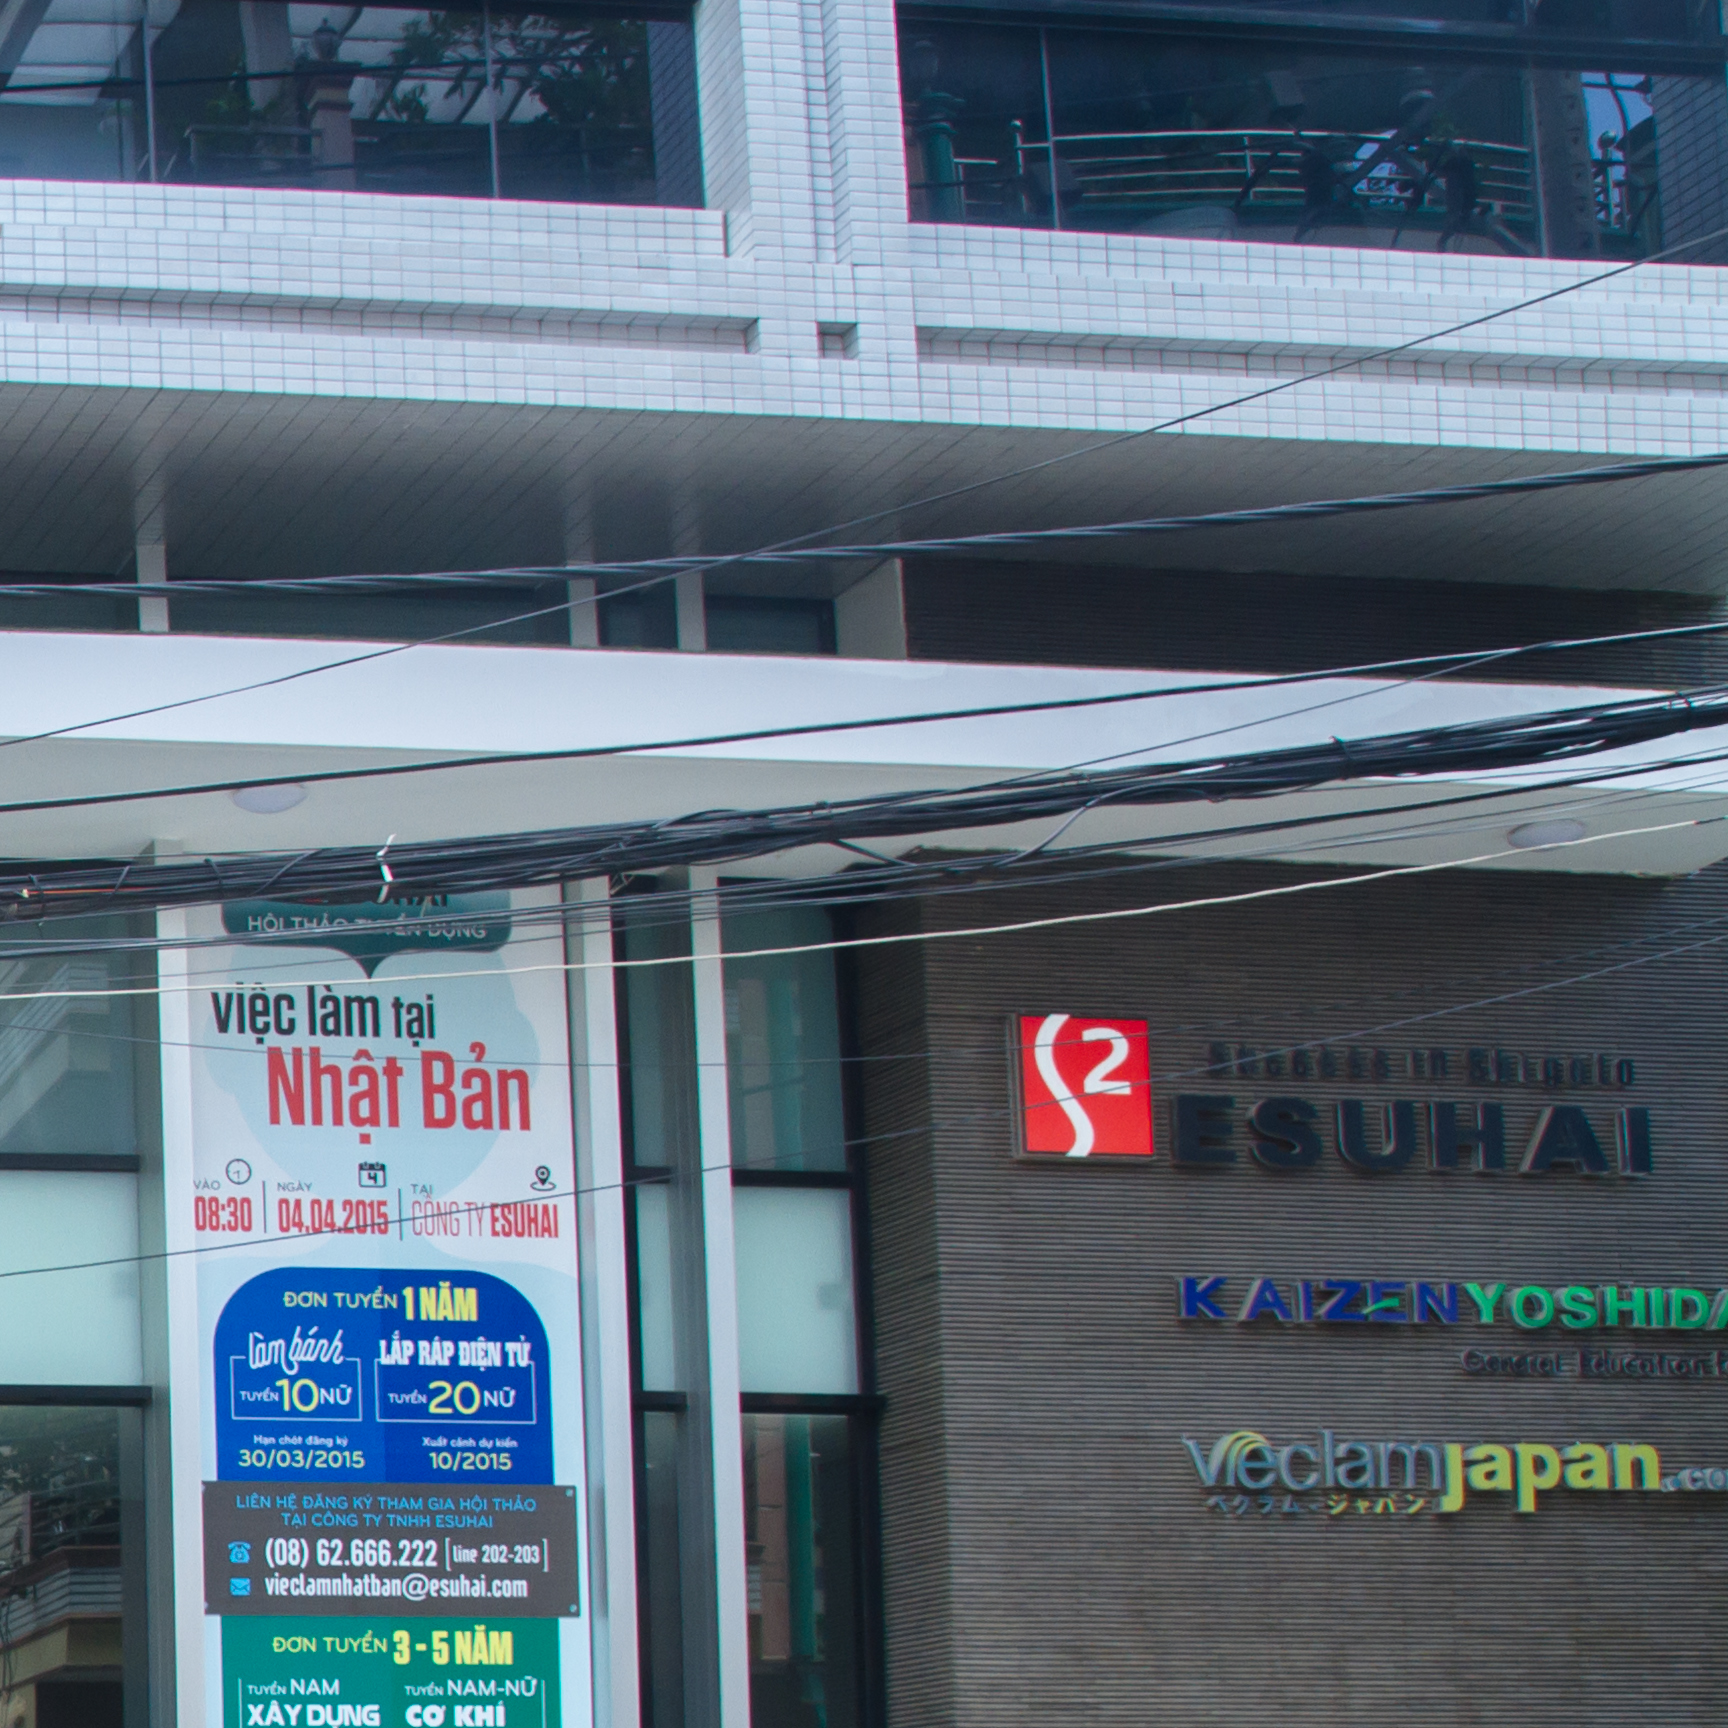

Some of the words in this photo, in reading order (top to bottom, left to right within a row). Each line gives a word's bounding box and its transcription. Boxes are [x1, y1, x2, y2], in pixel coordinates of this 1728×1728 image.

[210, 982, 294, 1044] việc
[307, 985, 381, 1038] làm
[392, 994, 435, 1047] tại
[266, 1046, 403, 1145] Nhật
[419, 1042, 532, 1132] Bản
[1170, 1096, 1653, 1176] ESUHAI
[194, 1178, 221, 1191] VÀO
[277, 1179, 313, 1193] NGÀY
[411, 1183, 433, 1198] TẠI
[194, 1196, 253, 1233] 08:30
[278, 1197, 389, 1235] 04.04.2015
[412, 1193, 459, 1237] CÔNG
[463, 1201, 485, 1237] TY
[490, 1201, 559, 1238] ESUHAI
[283, 1291, 328, 1308] ĐƠN
[333, 1285, 398, 1309] TUYỂN
[403, 1286, 415, 1321] 1
[420, 1282, 478, 1322] NĂM
[379, 1330, 414, 1366] LẮP
[418, 1336, 455, 1366] RÁP
[458, 1337, 502, 1372] ĐIỆN
[240, 1388, 279, 1402] TUYỂN
[275, 1378, 319, 1413] 10
[320, 1384, 352, 1406] NỮ
[388, 1389, 427, 1405] TUYỂN
[428, 1380, 481, 1415] 20
[483, 1387, 516, 1408] NỮ
[239, 1449, 366, 1470] 30/03/2015
[429, 1451, 513, 1471] 10/2015
[236, 1493, 271, 1509] LIÊN
[276, 1493, 297, 1512] HỆ
[302, 1494, 348, 1510] ĐĂNG
[378, 1496, 423, 1510] THAM
[428, 1497, 455, 1511] GIA
[460, 1494, 487, 1515] HỘI
[492, 1494, 536, 1512] THẢO
[282, 1512, 306, 1529] TẠI
[312, 1510, 358, 1528] CÔNG
[363, 1514, 382, 1527] TY
[387, 1514, 431, 1528] TNHH
[436, 1514, 494, 1529] ESUHAI
[265, 1537, 309, 1569] (08)
[317, 1539, 438, 1567] 62.666.222
[265, 1572, 528, 1601] vieclamnhatban@esuhai.com
[273, 1636, 317, 1653] ĐƠN
[323, 1630, 388, 1654] TUYỂN
[393, 1630, 410, 1665] 3
[432, 1630, 449, 1666] 5
[455, 1624, 513, 1666] NĂM
[247, 1681, 287, 1695] TUYỂN
[290, 1679, 340, 1695] NAM
[405, 1682, 444, 1696] TUYỂN
[447, 1675, 538, 1697] NAM-NỮ
[247, 1700, 302, 1727] XÂY
[405, 1704, 446, 1727] CƠ
[454, 1700, 506, 1727] KHÍ
